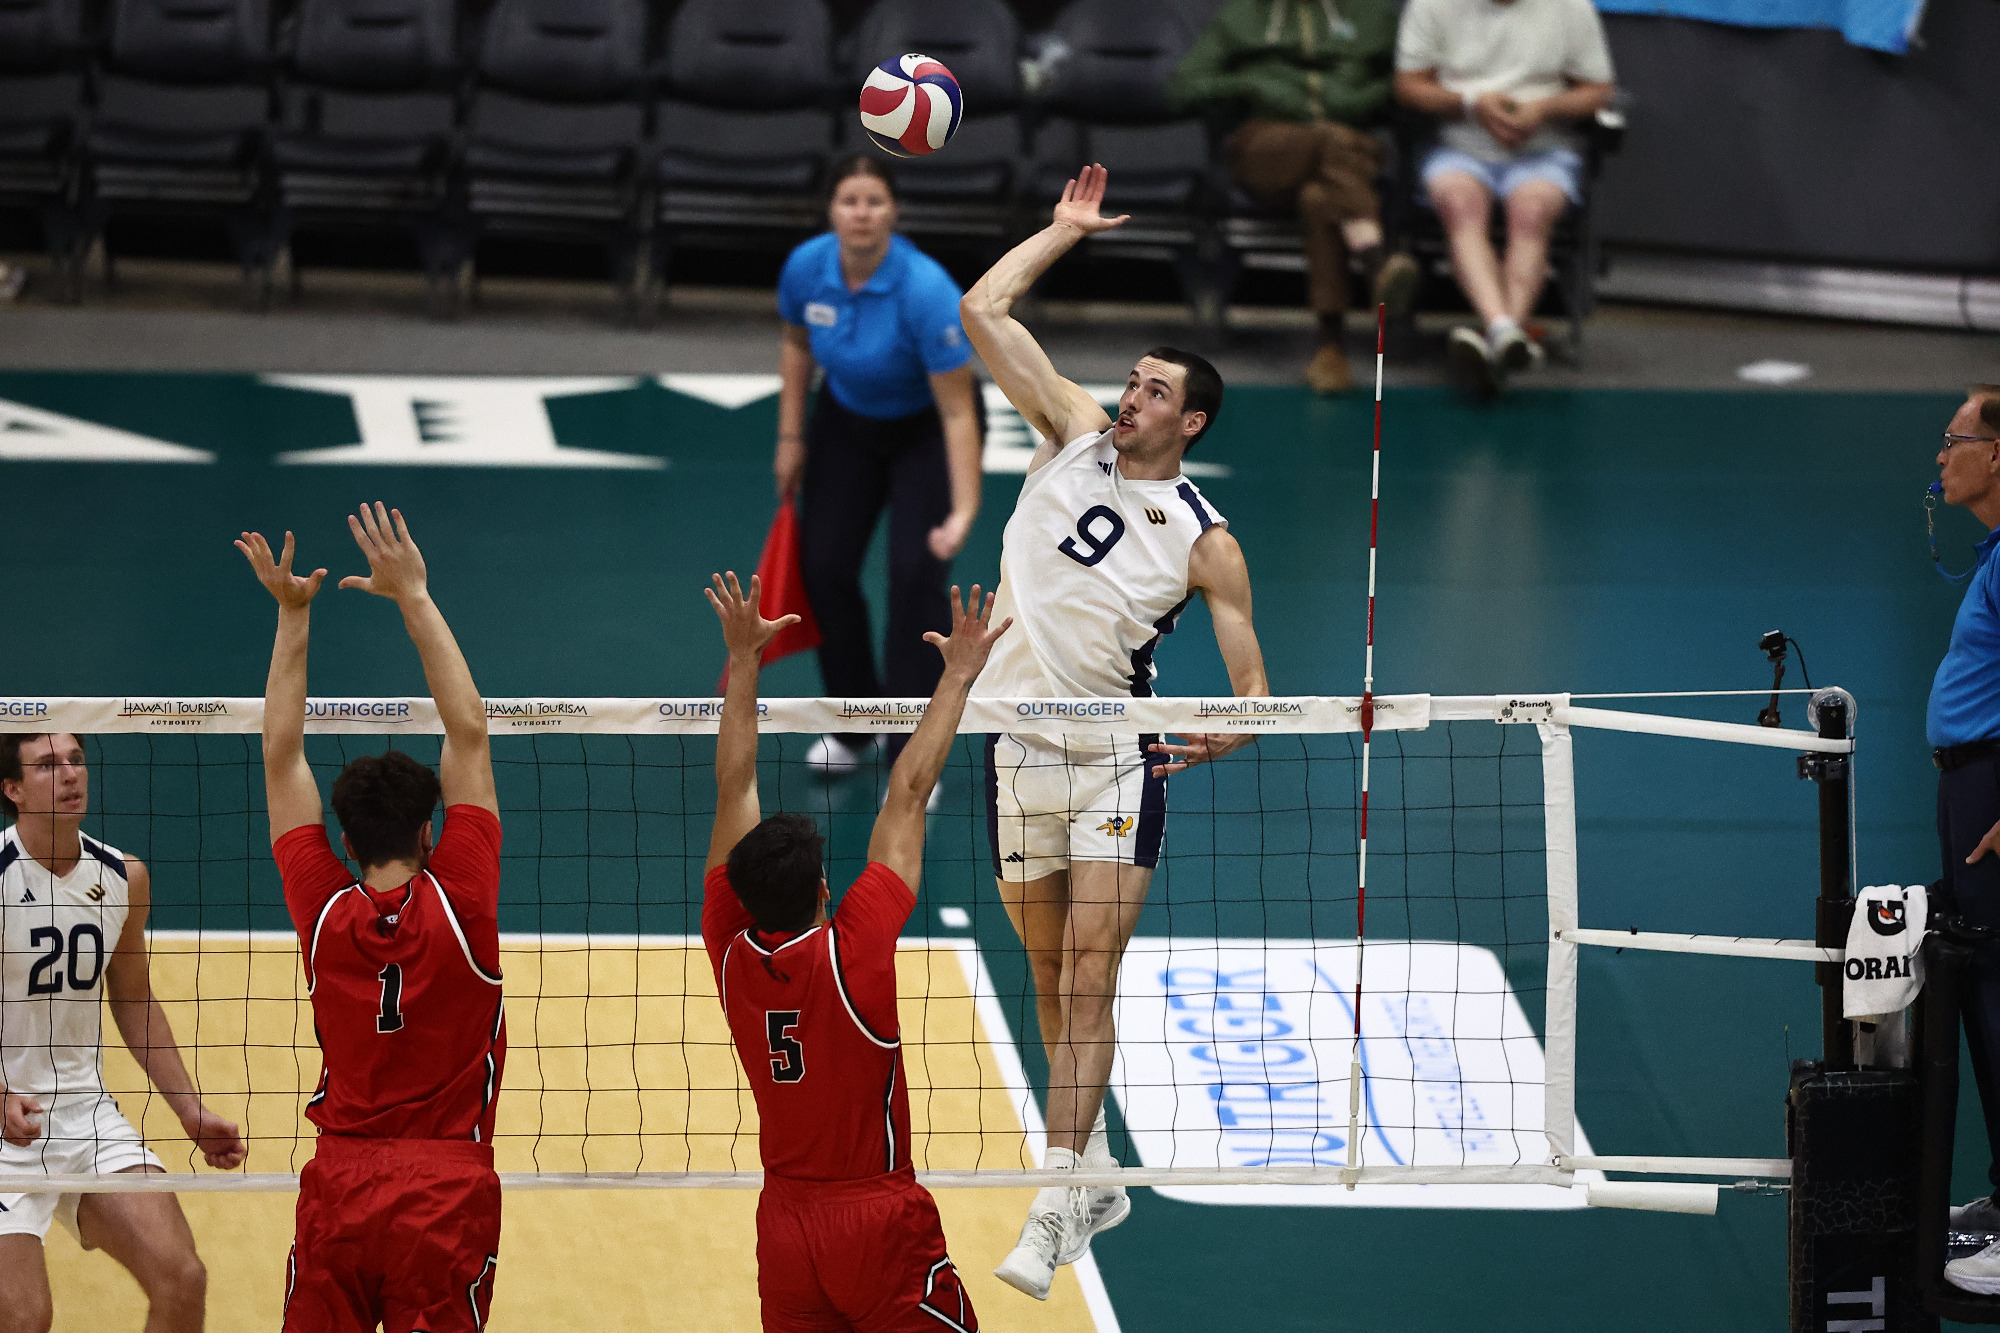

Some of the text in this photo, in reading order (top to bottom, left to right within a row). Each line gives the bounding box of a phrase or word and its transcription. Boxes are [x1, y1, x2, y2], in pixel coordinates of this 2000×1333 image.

[1058, 504, 1126, 568] 9
[176, 701, 228, 715] TOURISM
[536, 702, 588, 716] TOURISM
[894, 702, 929, 715] TOURI
[1016, 702, 1126, 717] OUTRIGGER
[1251, 701, 1303, 715] TOURISM
[1518, 700, 1551, 708] Senoh
[511, 719, 562, 727] AUTHORITY
[28, 923, 104, 997] 20
[376, 962, 405, 1034] 1
[765, 1010, 806, 1083] 5
[1157, 966, 1348, 1167] UTRIGGER
